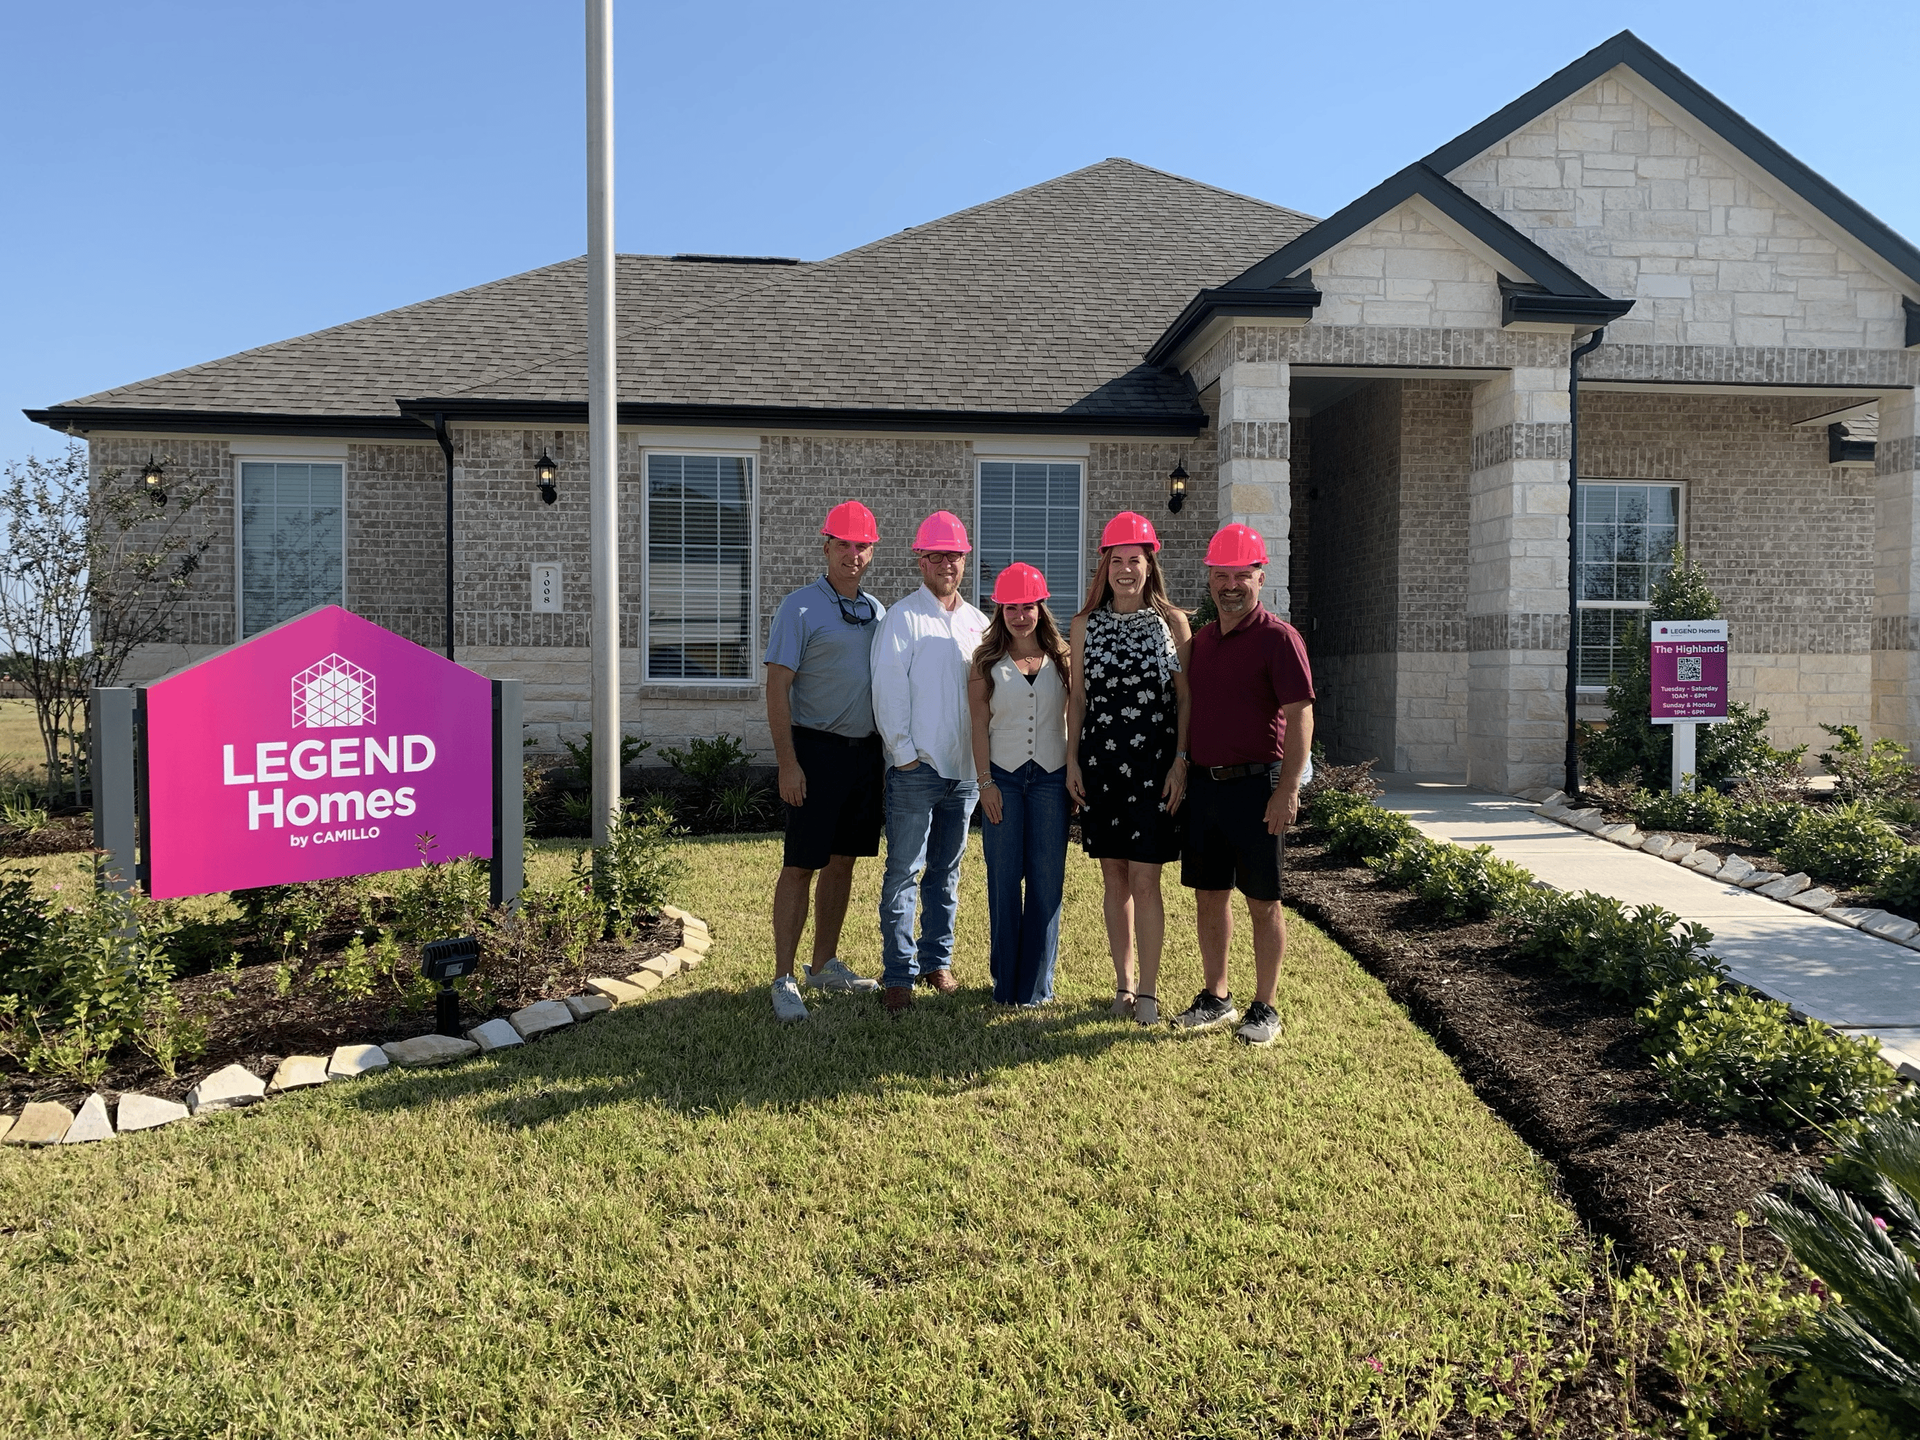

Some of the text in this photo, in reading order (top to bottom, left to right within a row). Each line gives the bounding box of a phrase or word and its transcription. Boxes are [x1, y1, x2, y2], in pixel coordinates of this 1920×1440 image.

[543, 570, 551, 604] 3008
[1654, 644, 1725, 655] The Highlands
[223, 734, 436, 785] LEGEND
[248, 786, 416, 830] Homes
[290, 826, 380, 848] by CAMILLO
